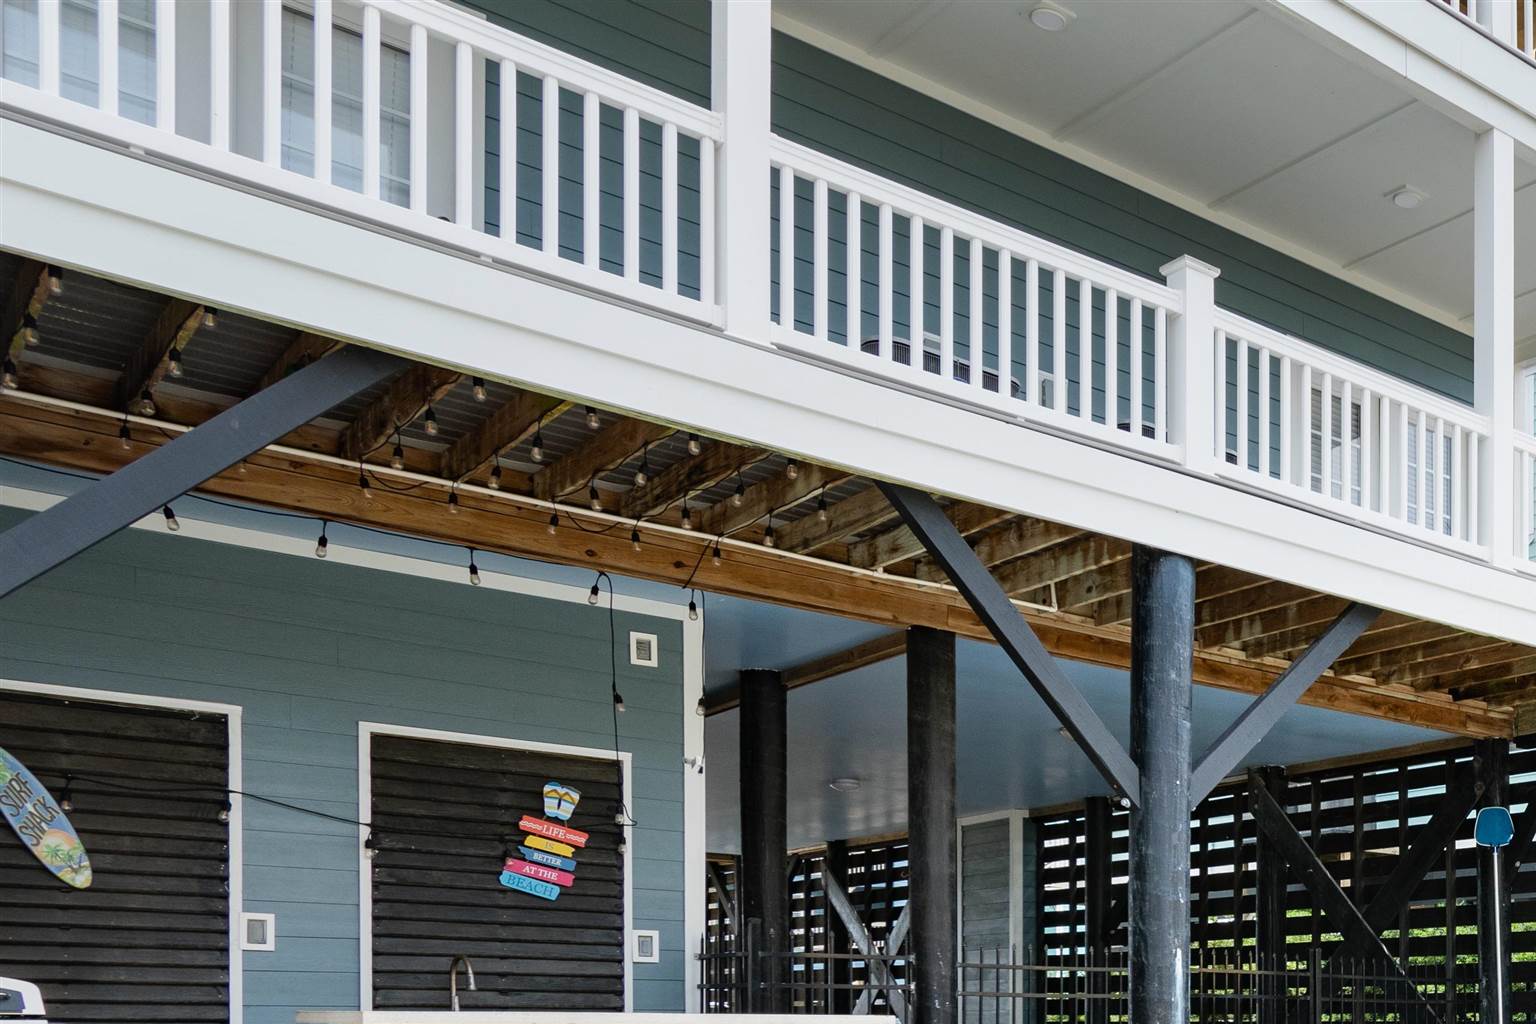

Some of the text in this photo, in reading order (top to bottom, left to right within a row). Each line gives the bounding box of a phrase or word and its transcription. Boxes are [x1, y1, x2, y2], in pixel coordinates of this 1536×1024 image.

[0, 772, 33, 817] SURF
[19, 796, 60, 847] SHACK
[542, 825, 566, 839] LIFE
[544, 841, 553, 849] IS
[533, 853, 562, 865] BETTER
[523, 865, 558, 880] AT THE
[507, 874, 553, 896] BEACH
